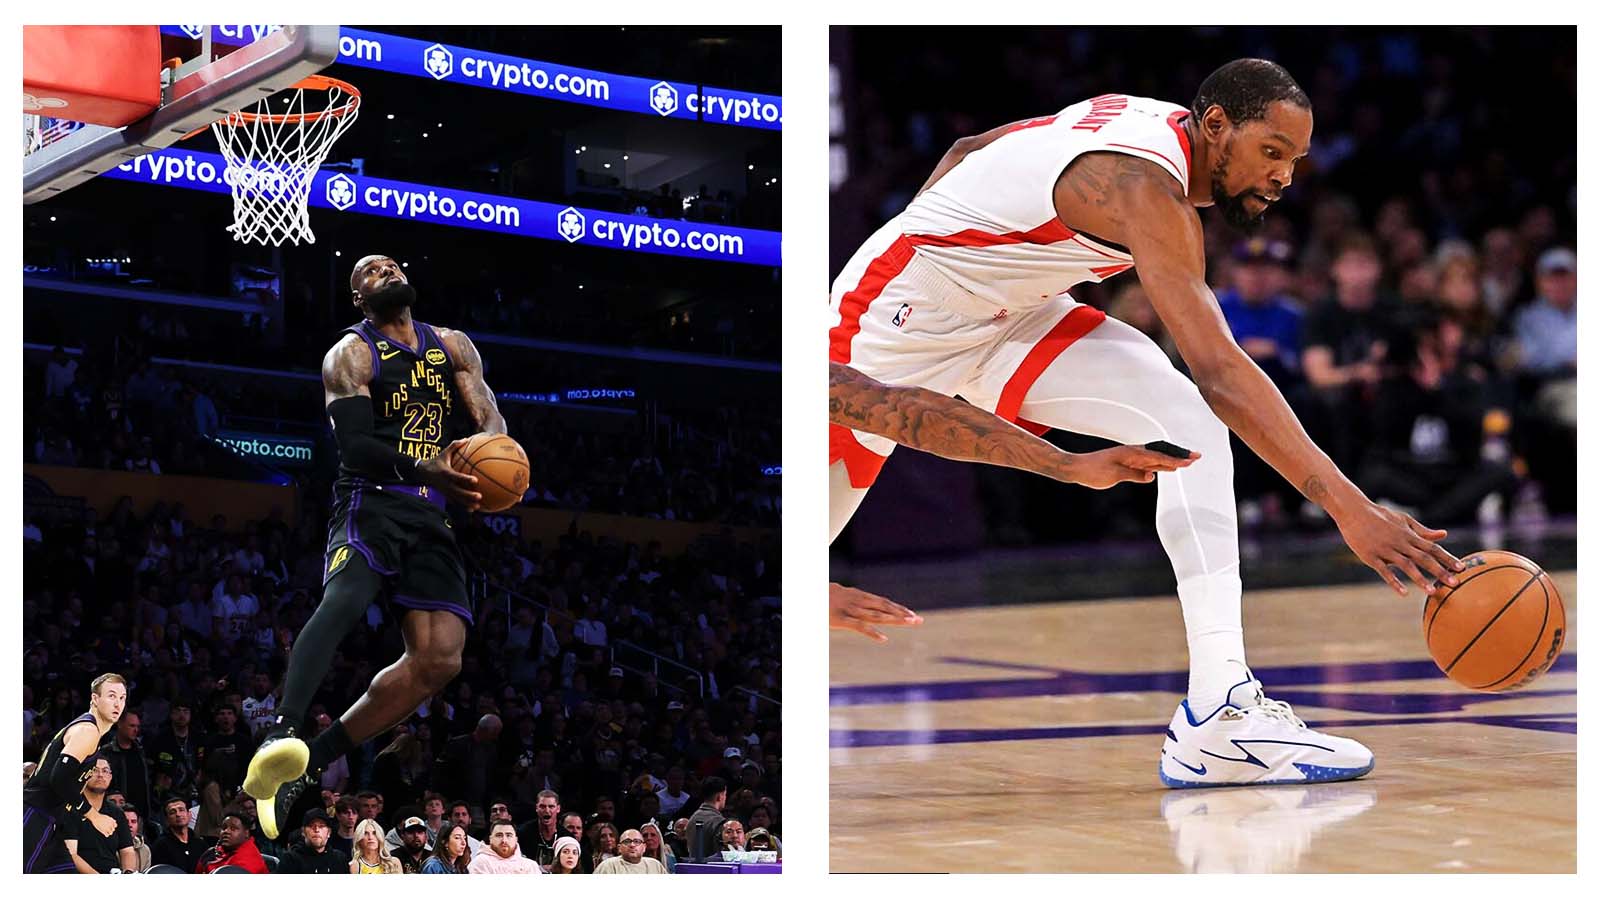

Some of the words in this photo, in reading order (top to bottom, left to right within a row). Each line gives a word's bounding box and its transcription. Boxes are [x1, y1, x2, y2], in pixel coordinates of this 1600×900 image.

[460, 57, 610, 101] crypto.com
[364, 186, 520, 227] crypto.com
[592, 220, 744, 255] crypto.com
[384, 384, 409, 417] LOS
[401, 402, 443, 443] 23
